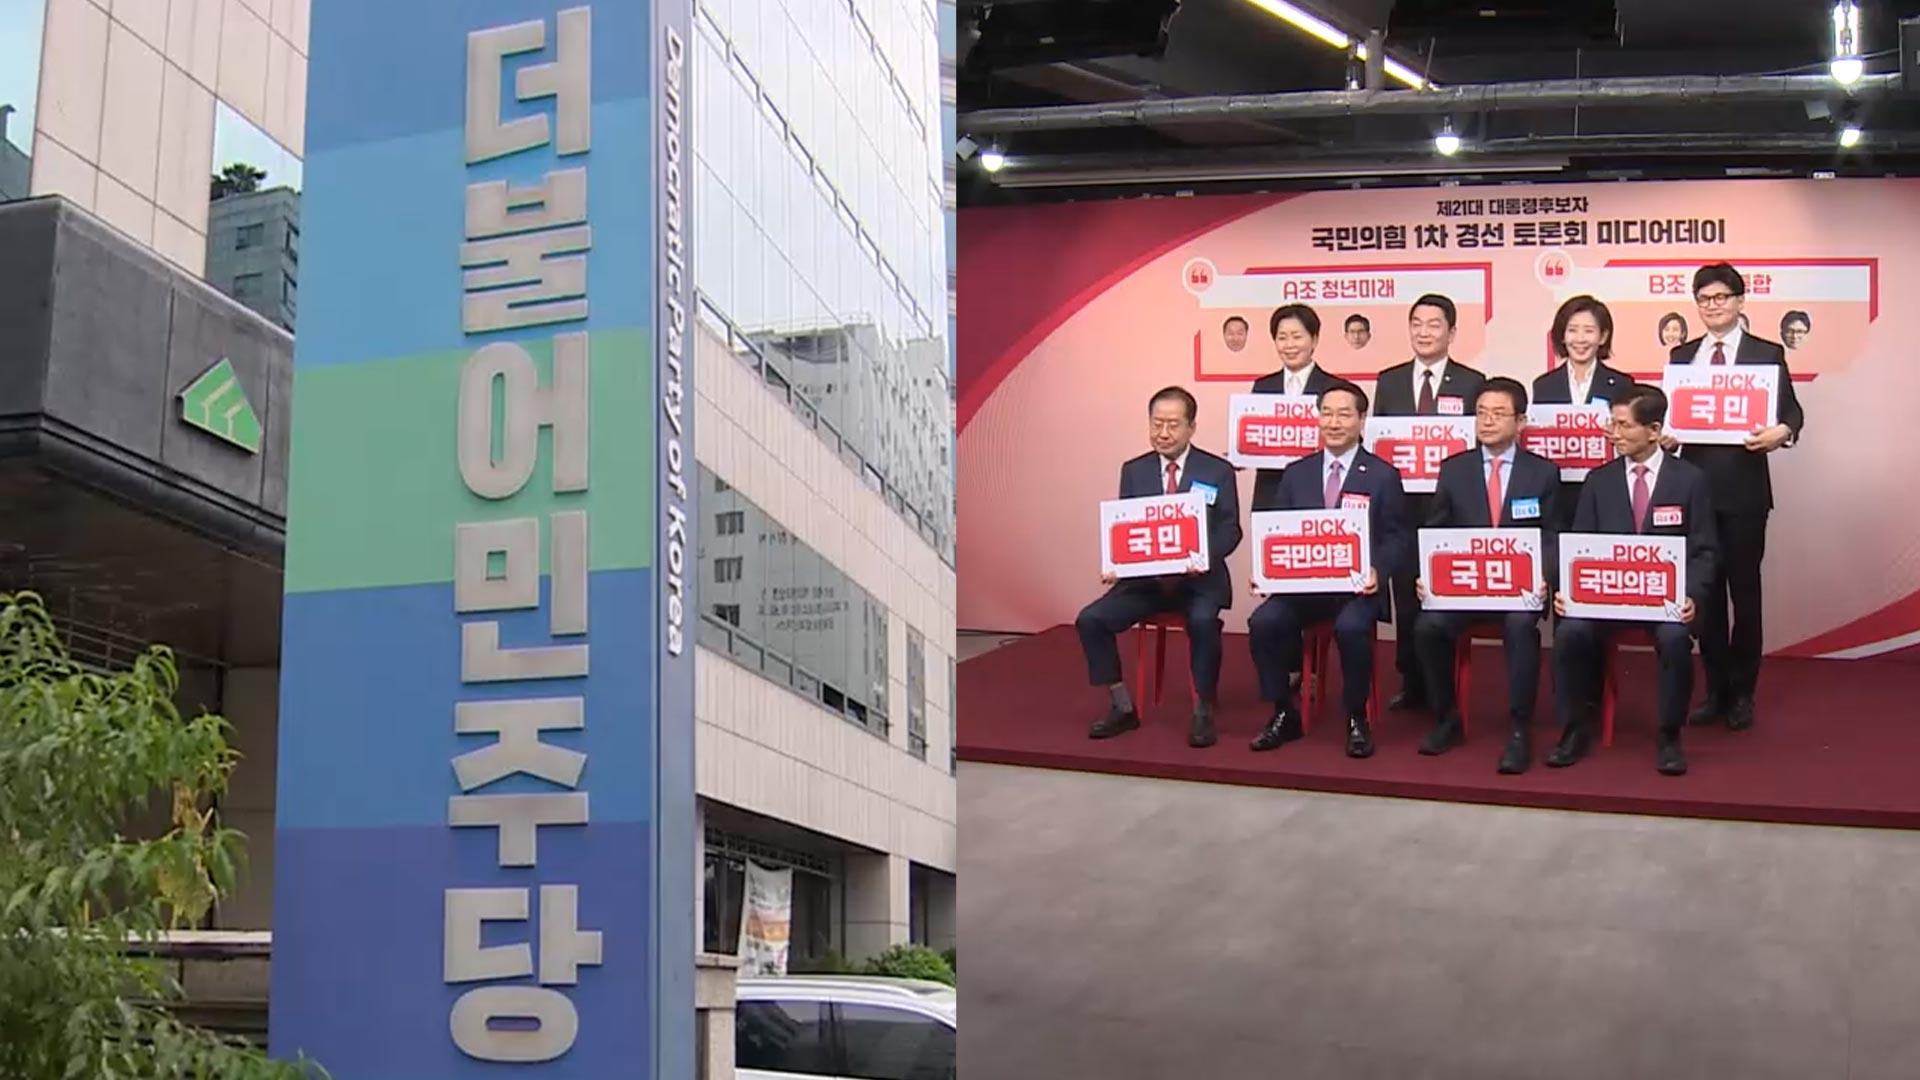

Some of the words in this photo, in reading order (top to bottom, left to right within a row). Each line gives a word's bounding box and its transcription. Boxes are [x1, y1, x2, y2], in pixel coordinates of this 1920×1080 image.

[666, 25, 684, 294] Democratic
[1436, 199, 1483, 217] 제21대
[1489, 196, 1588, 216] 대통령후보자
[1311, 224, 1406, 252] 국민의힘
[1414, 222, 1448, 250] 1차
[1456, 220, 1506, 249] 경선
[1513, 219, 1588, 247] 토론회
[1597, 217, 1726, 246] 미디어데이
[1284, 280, 1316, 300] A조
[1322, 278, 1395, 298] 청년미래
[1649, 274, 1685, 294] B조
[1712, 373, 1756, 390] PICK
[1275, 403, 1314, 419] PICK
[1557, 412, 1599, 429] PICK
[1245, 424, 1319, 448] 국민의힘
[1412, 425, 1454, 440] PICK
[1526, 435, 1606, 459] 국민의힘
[667, 440, 687, 500] of
[1146, 502, 1185, 521] PICK
[444, 6, 602, 1062] 더불어민주당
[1302, 518, 1346, 536] PICK
[1270, 543, 1353, 570] 국민의힘
[1471, 537, 1517, 555] PICK
[1613, 544, 1661, 563] PICK
[667, 505, 687, 657] Korea
[1579, 568, 1668, 596] 국민의힘
